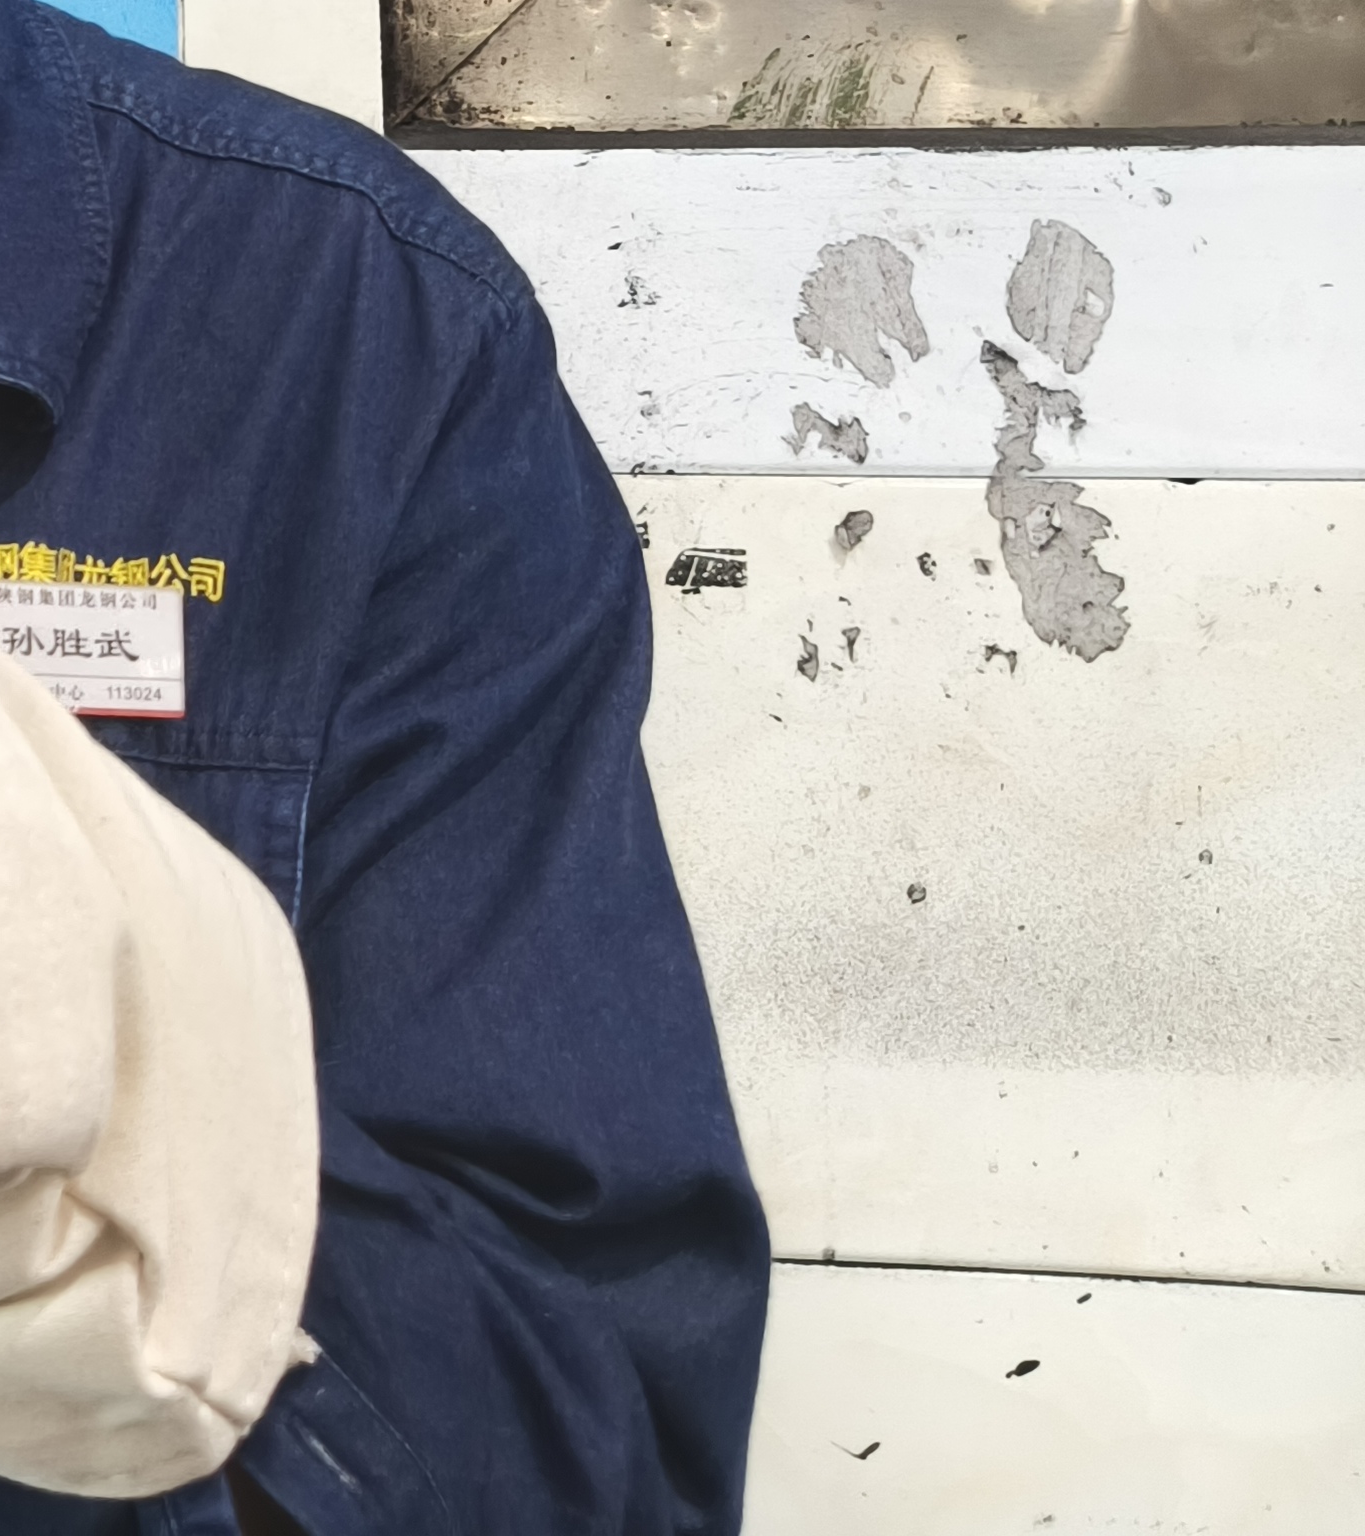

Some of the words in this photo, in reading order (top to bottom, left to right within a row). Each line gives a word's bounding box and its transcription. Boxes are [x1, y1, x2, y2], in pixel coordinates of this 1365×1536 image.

[2, 625, 140, 662] 孙胜武
[106, 686, 162, 701] 113024
